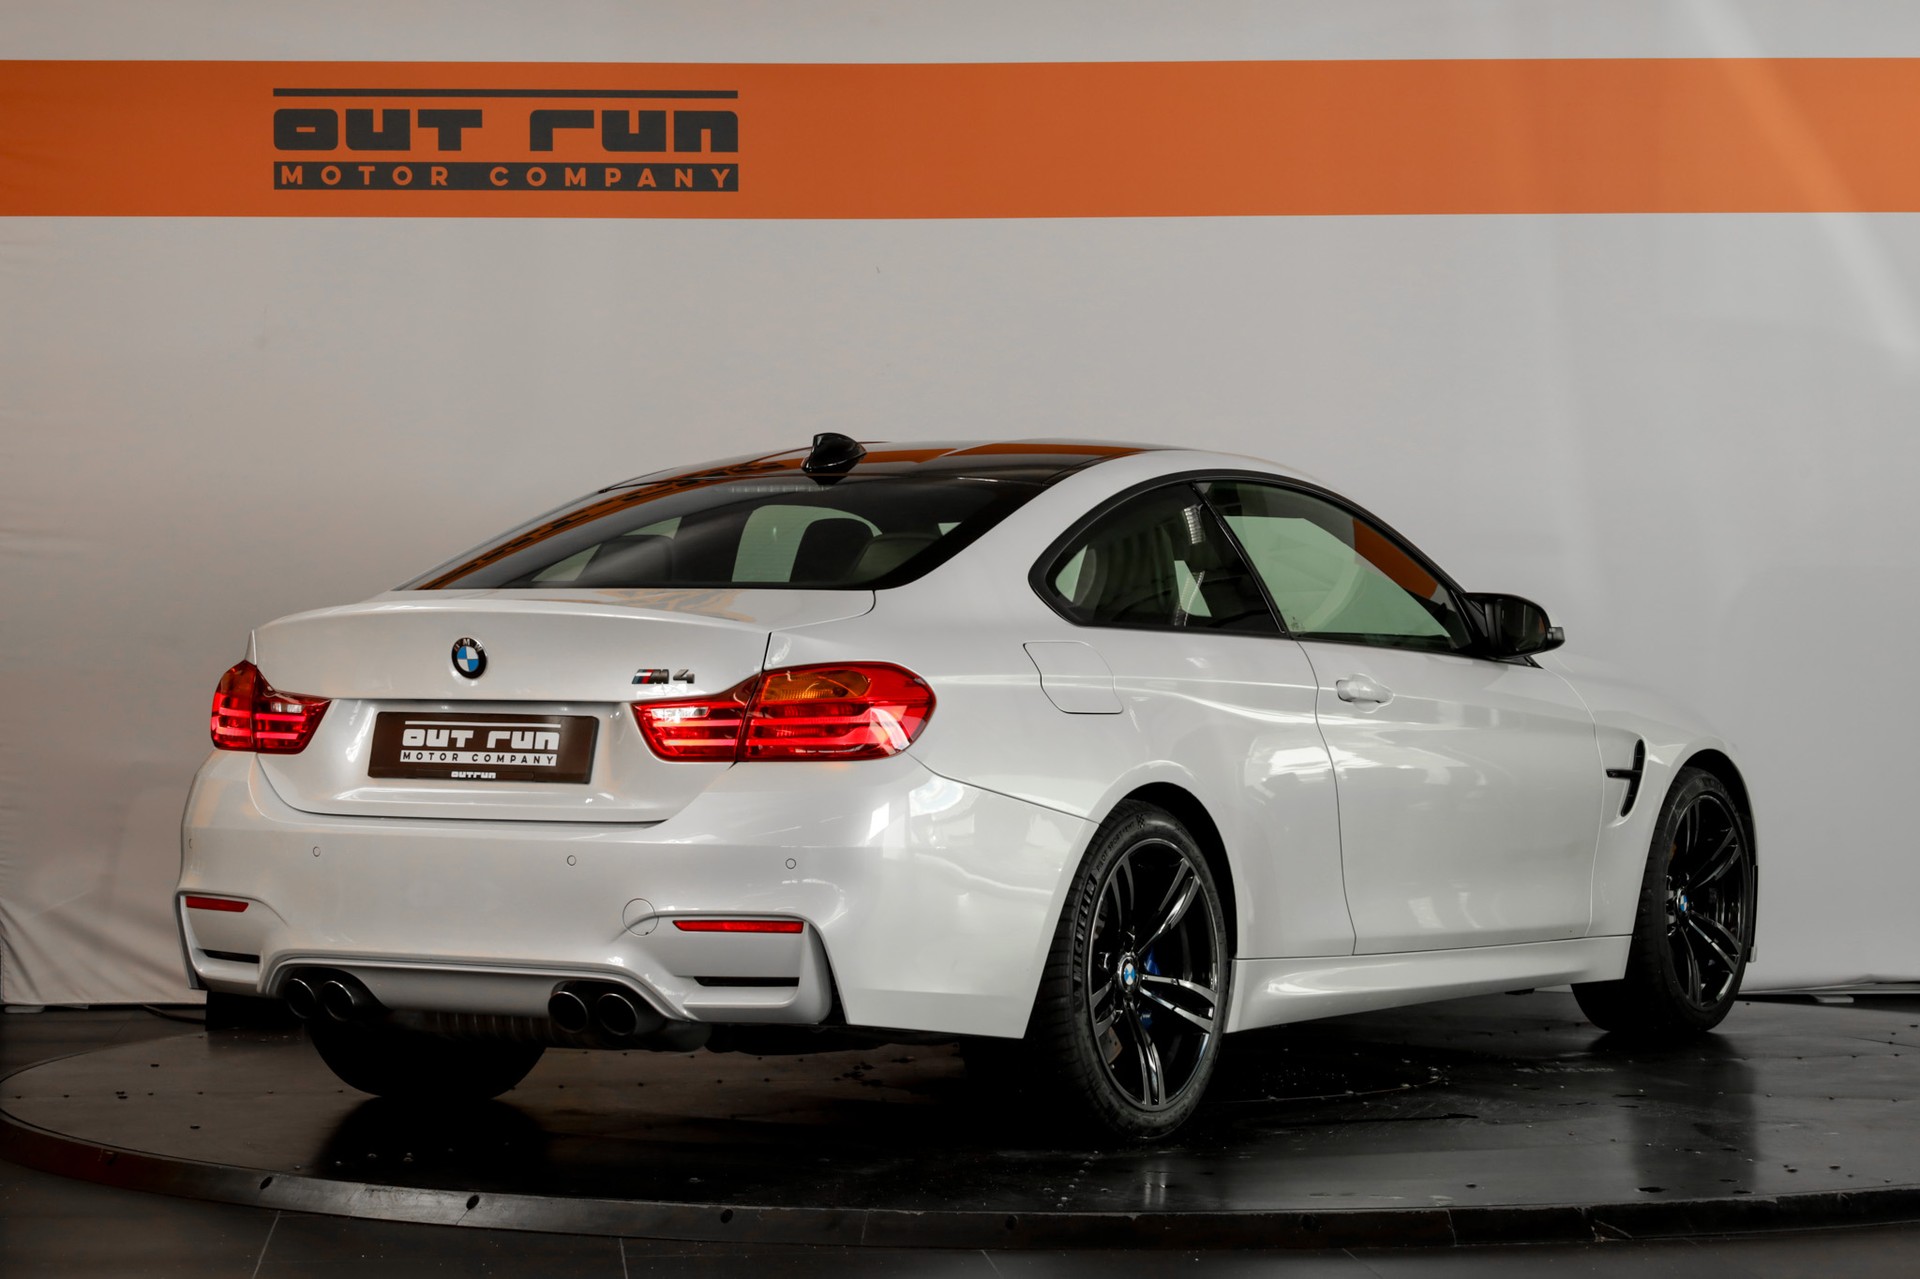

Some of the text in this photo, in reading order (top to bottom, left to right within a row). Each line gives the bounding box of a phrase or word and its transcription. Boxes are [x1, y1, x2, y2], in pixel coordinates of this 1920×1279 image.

[280, 165, 731, 188] MOTOR COMPANY
[453, 638, 483, 652] BMW
[402, 751, 554, 764] MOTOR COMPANY
[1096, 850, 1108, 872] PILOT
[1072, 872, 1098, 985] MICHELIN
